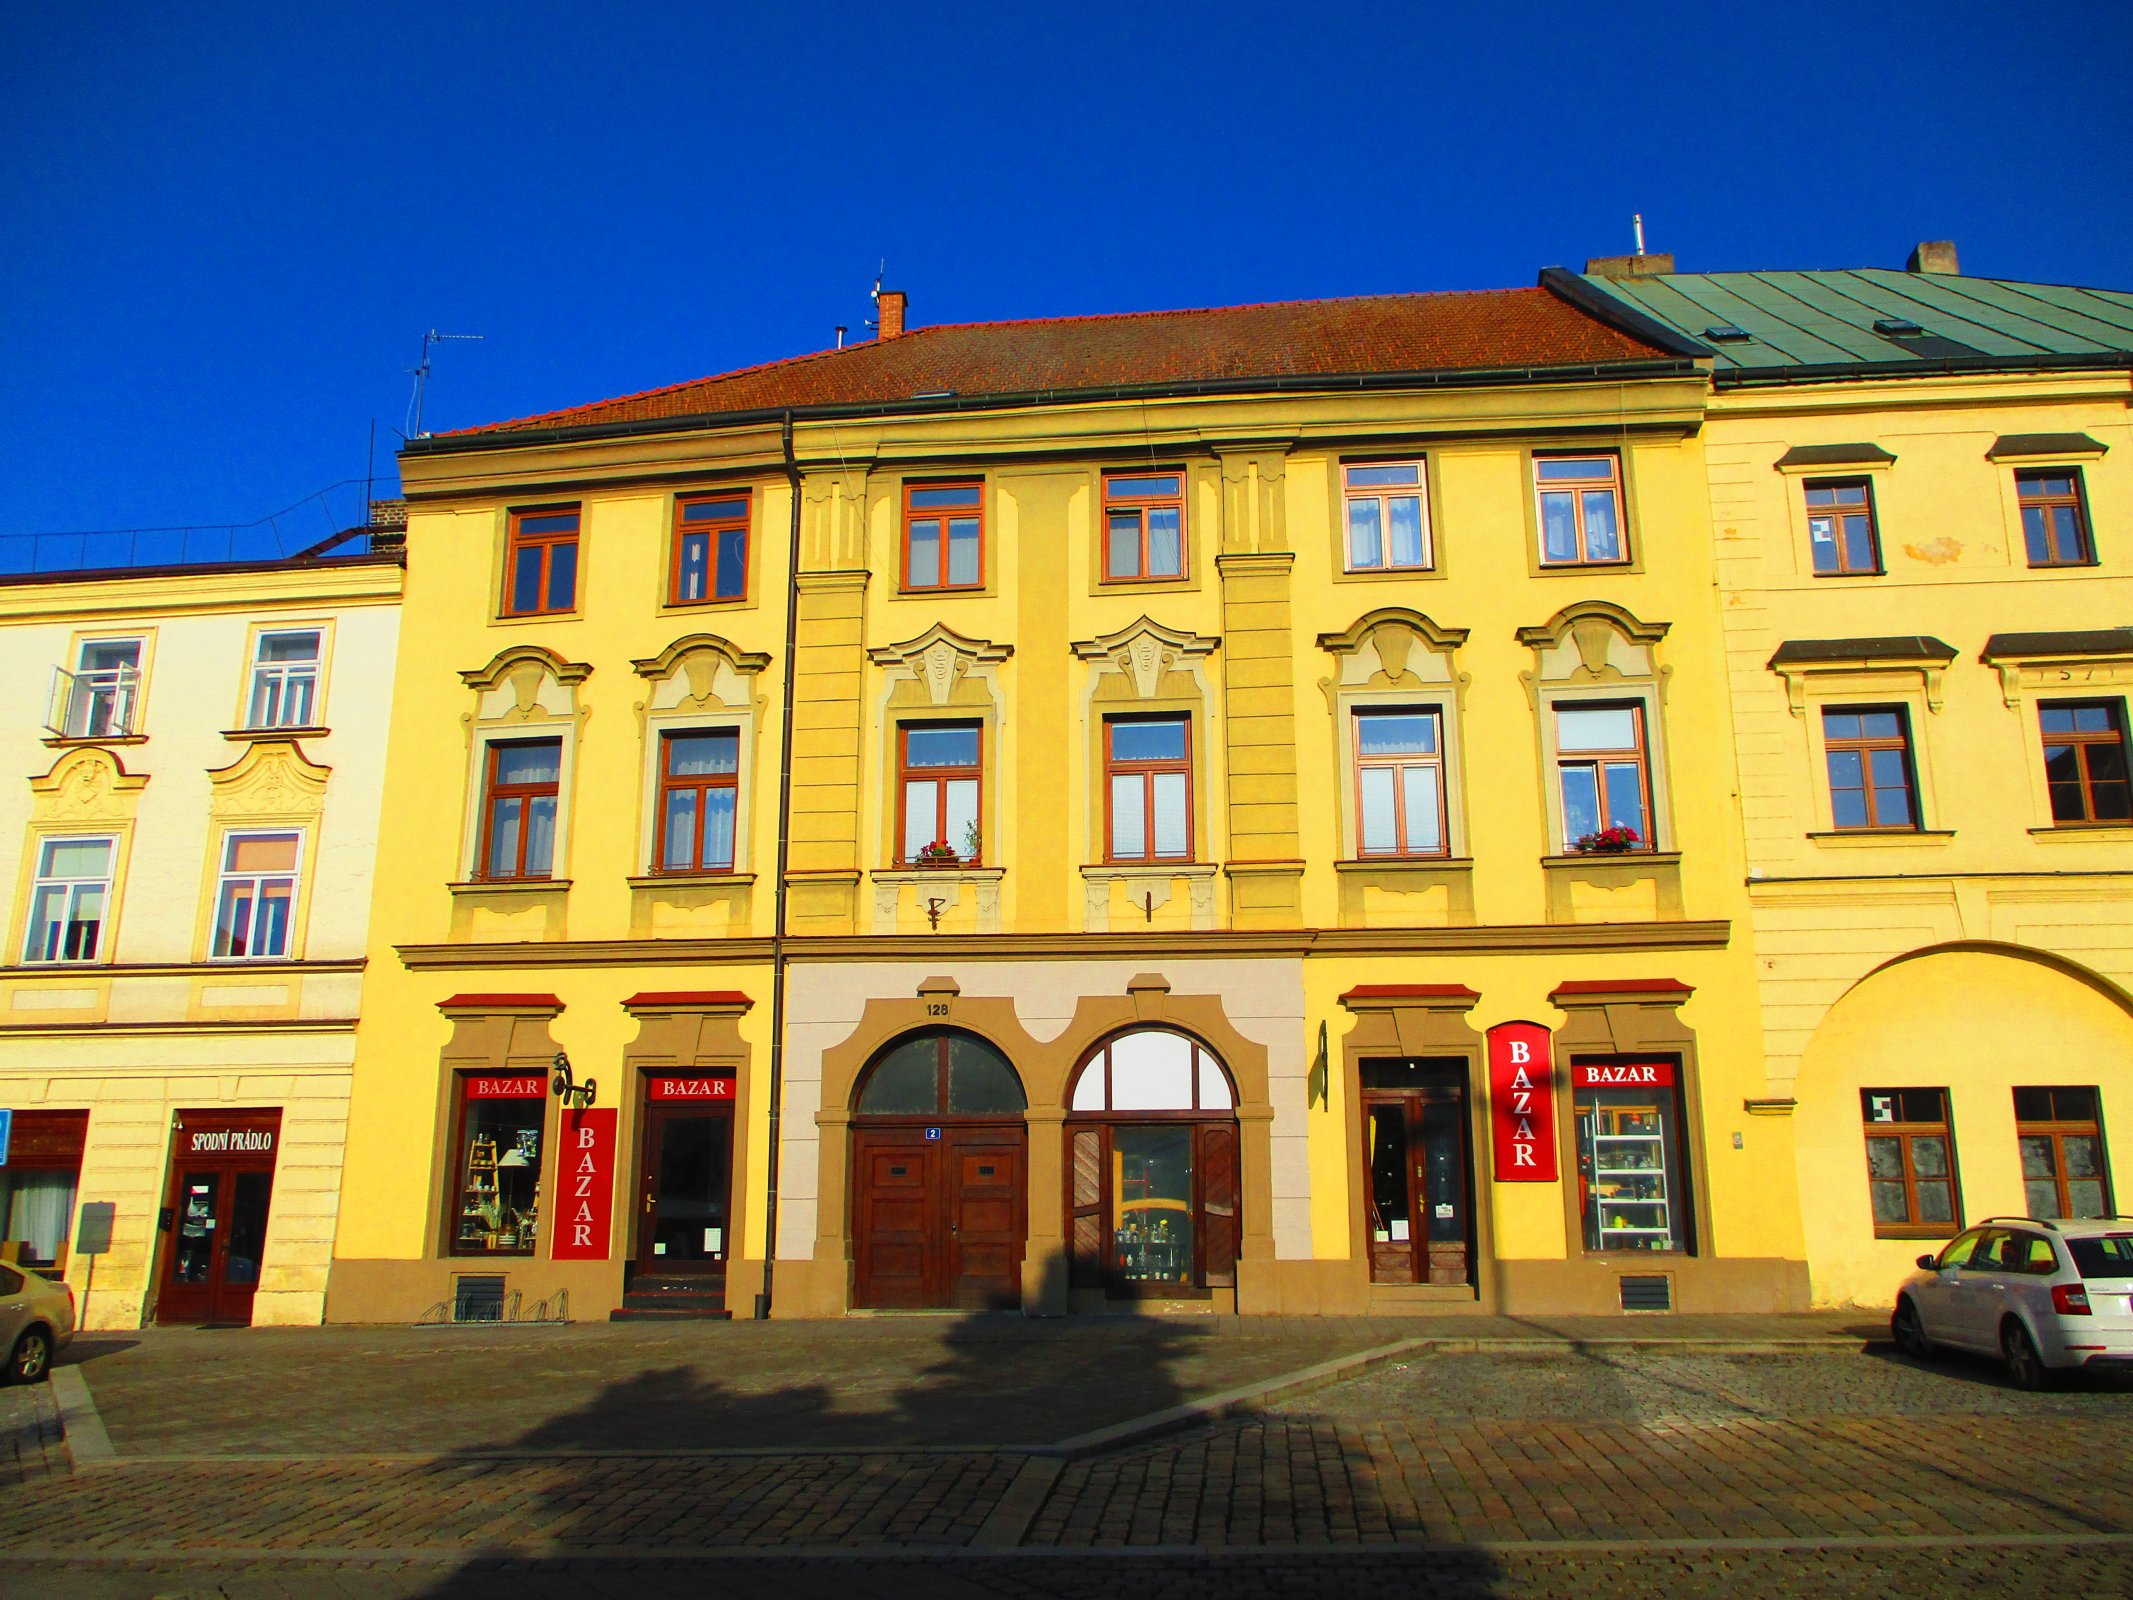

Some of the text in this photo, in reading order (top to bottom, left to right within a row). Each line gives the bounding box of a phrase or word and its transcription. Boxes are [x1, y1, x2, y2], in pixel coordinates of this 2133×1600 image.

[926, 1003, 949, 1017] 128
[1585, 1066, 1658, 1083] BAZAR
[477, 1080, 538, 1095] BAZAR
[663, 1080, 726, 1096] BAZAR
[1508, 1041, 1537, 1167] BAZAR
[191, 1128, 272, 1151] SPODNÍ PRÁDLO
[930, 1129, 936, 1138] 2
[571, 1127, 597, 1246] BAZAR
